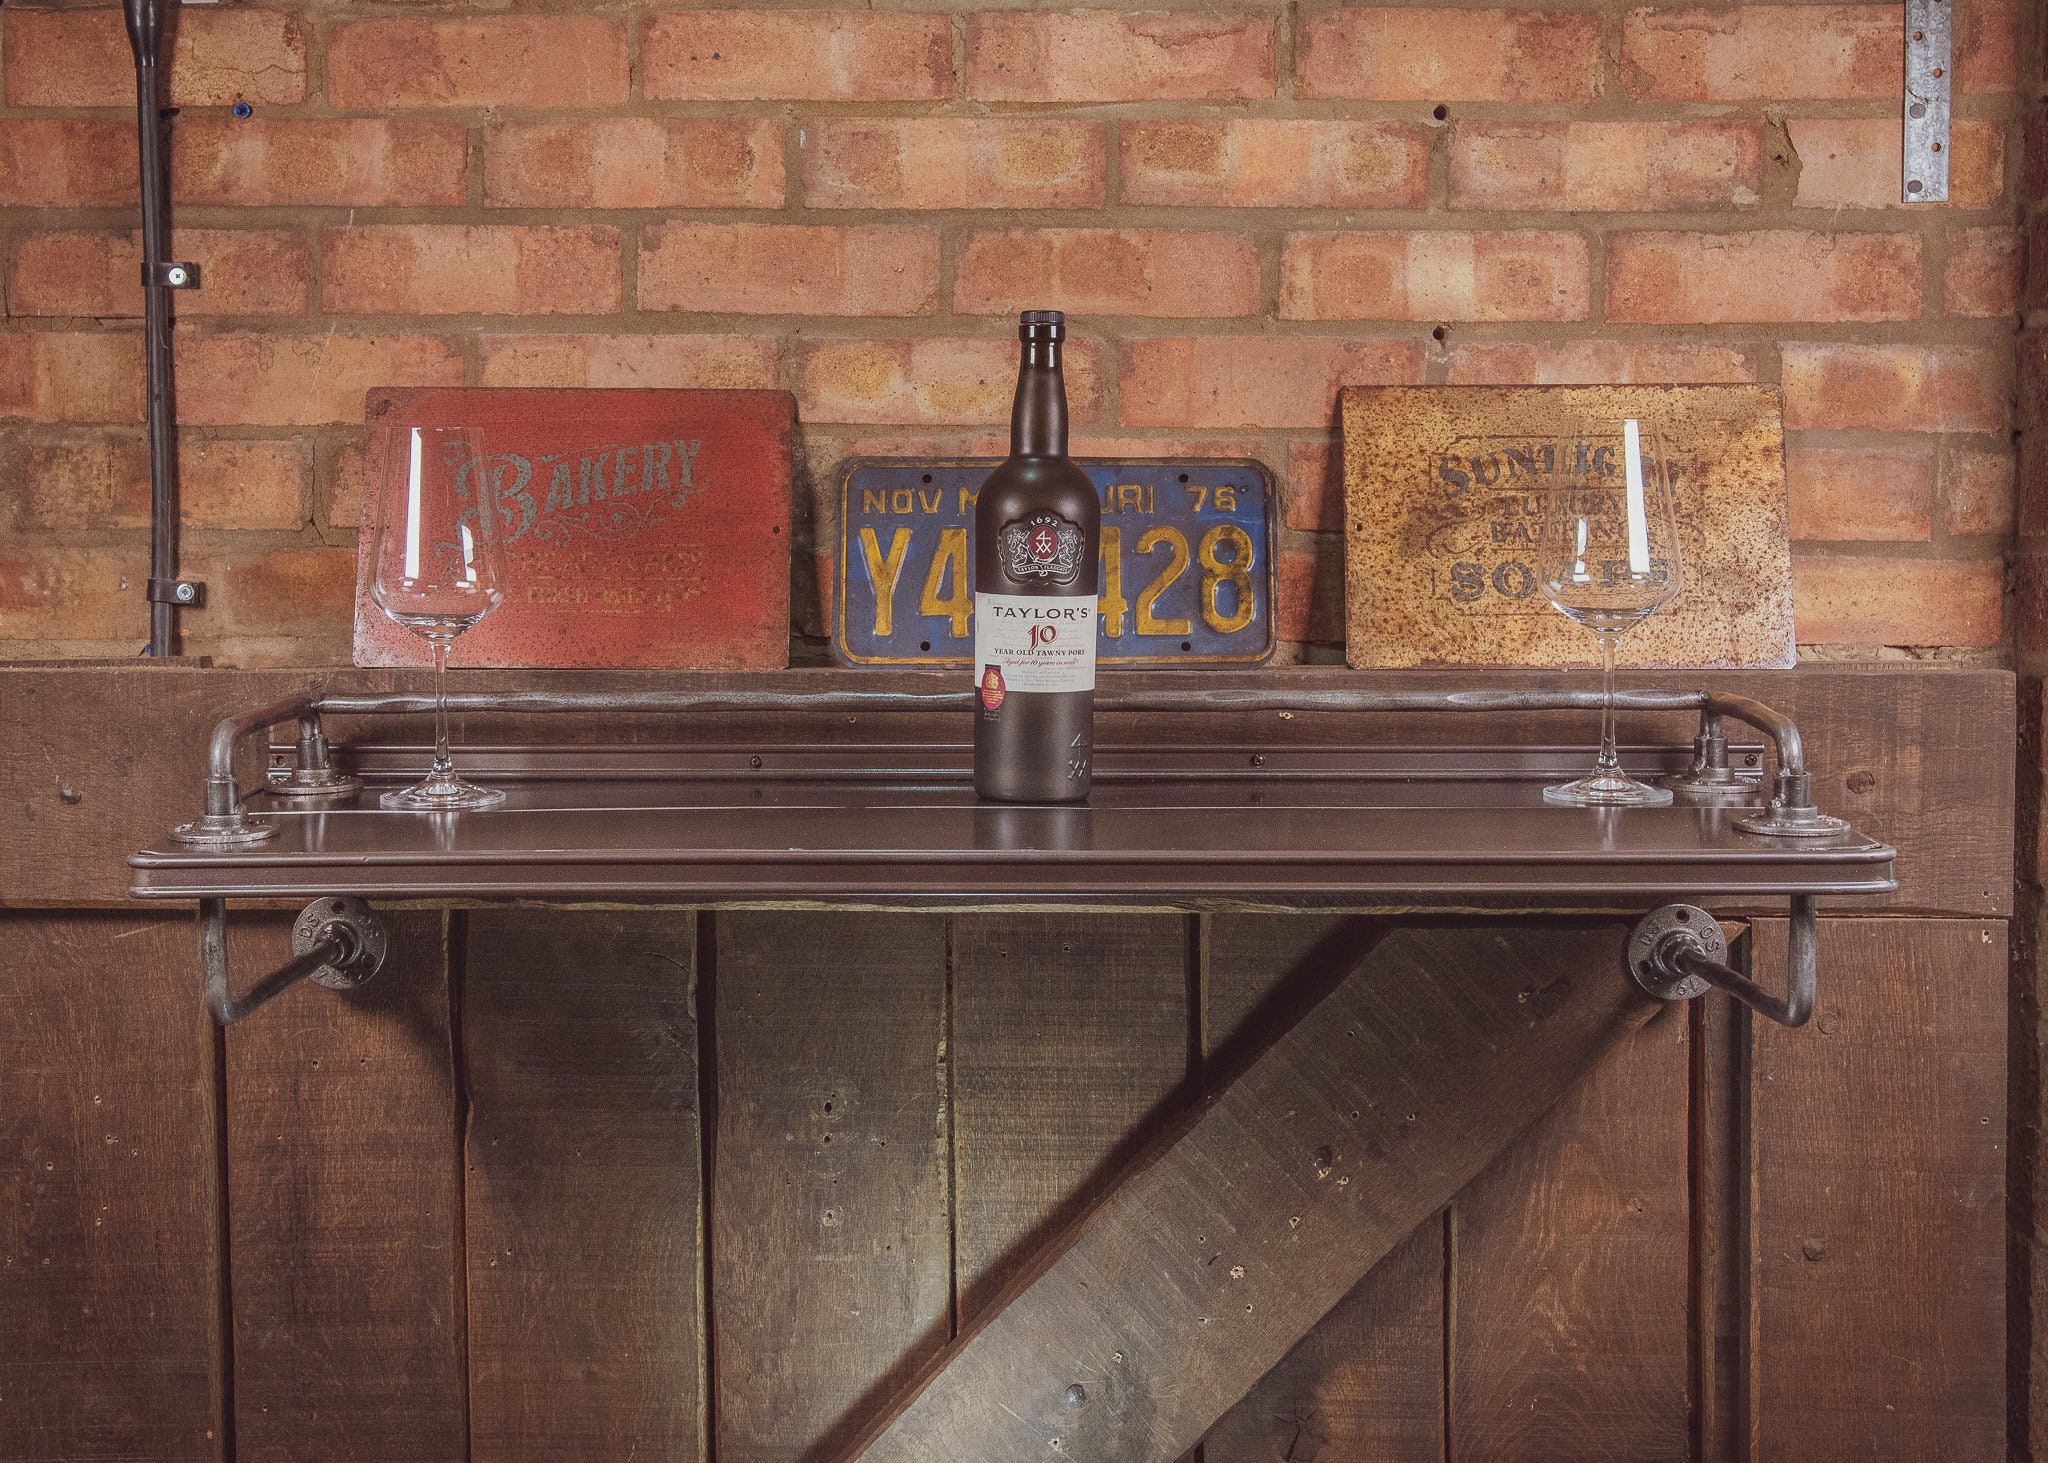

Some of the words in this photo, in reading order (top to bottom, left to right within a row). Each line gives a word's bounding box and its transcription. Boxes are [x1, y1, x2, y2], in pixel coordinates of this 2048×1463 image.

[454, 439, 703, 546] BAKERY
[862, 487, 943, 515] NOV
[1185, 485, 1237, 513] 76
[1030, 516, 1058, 527] 1692
[1490, 521, 1631, 544] BATHNG
[859, 527, 975, 639] Y4
[1097, 524, 1255, 639] 428
[993, 606, 1088, 620] TAYLOR'S
[1027, 624, 1059, 650] 10
